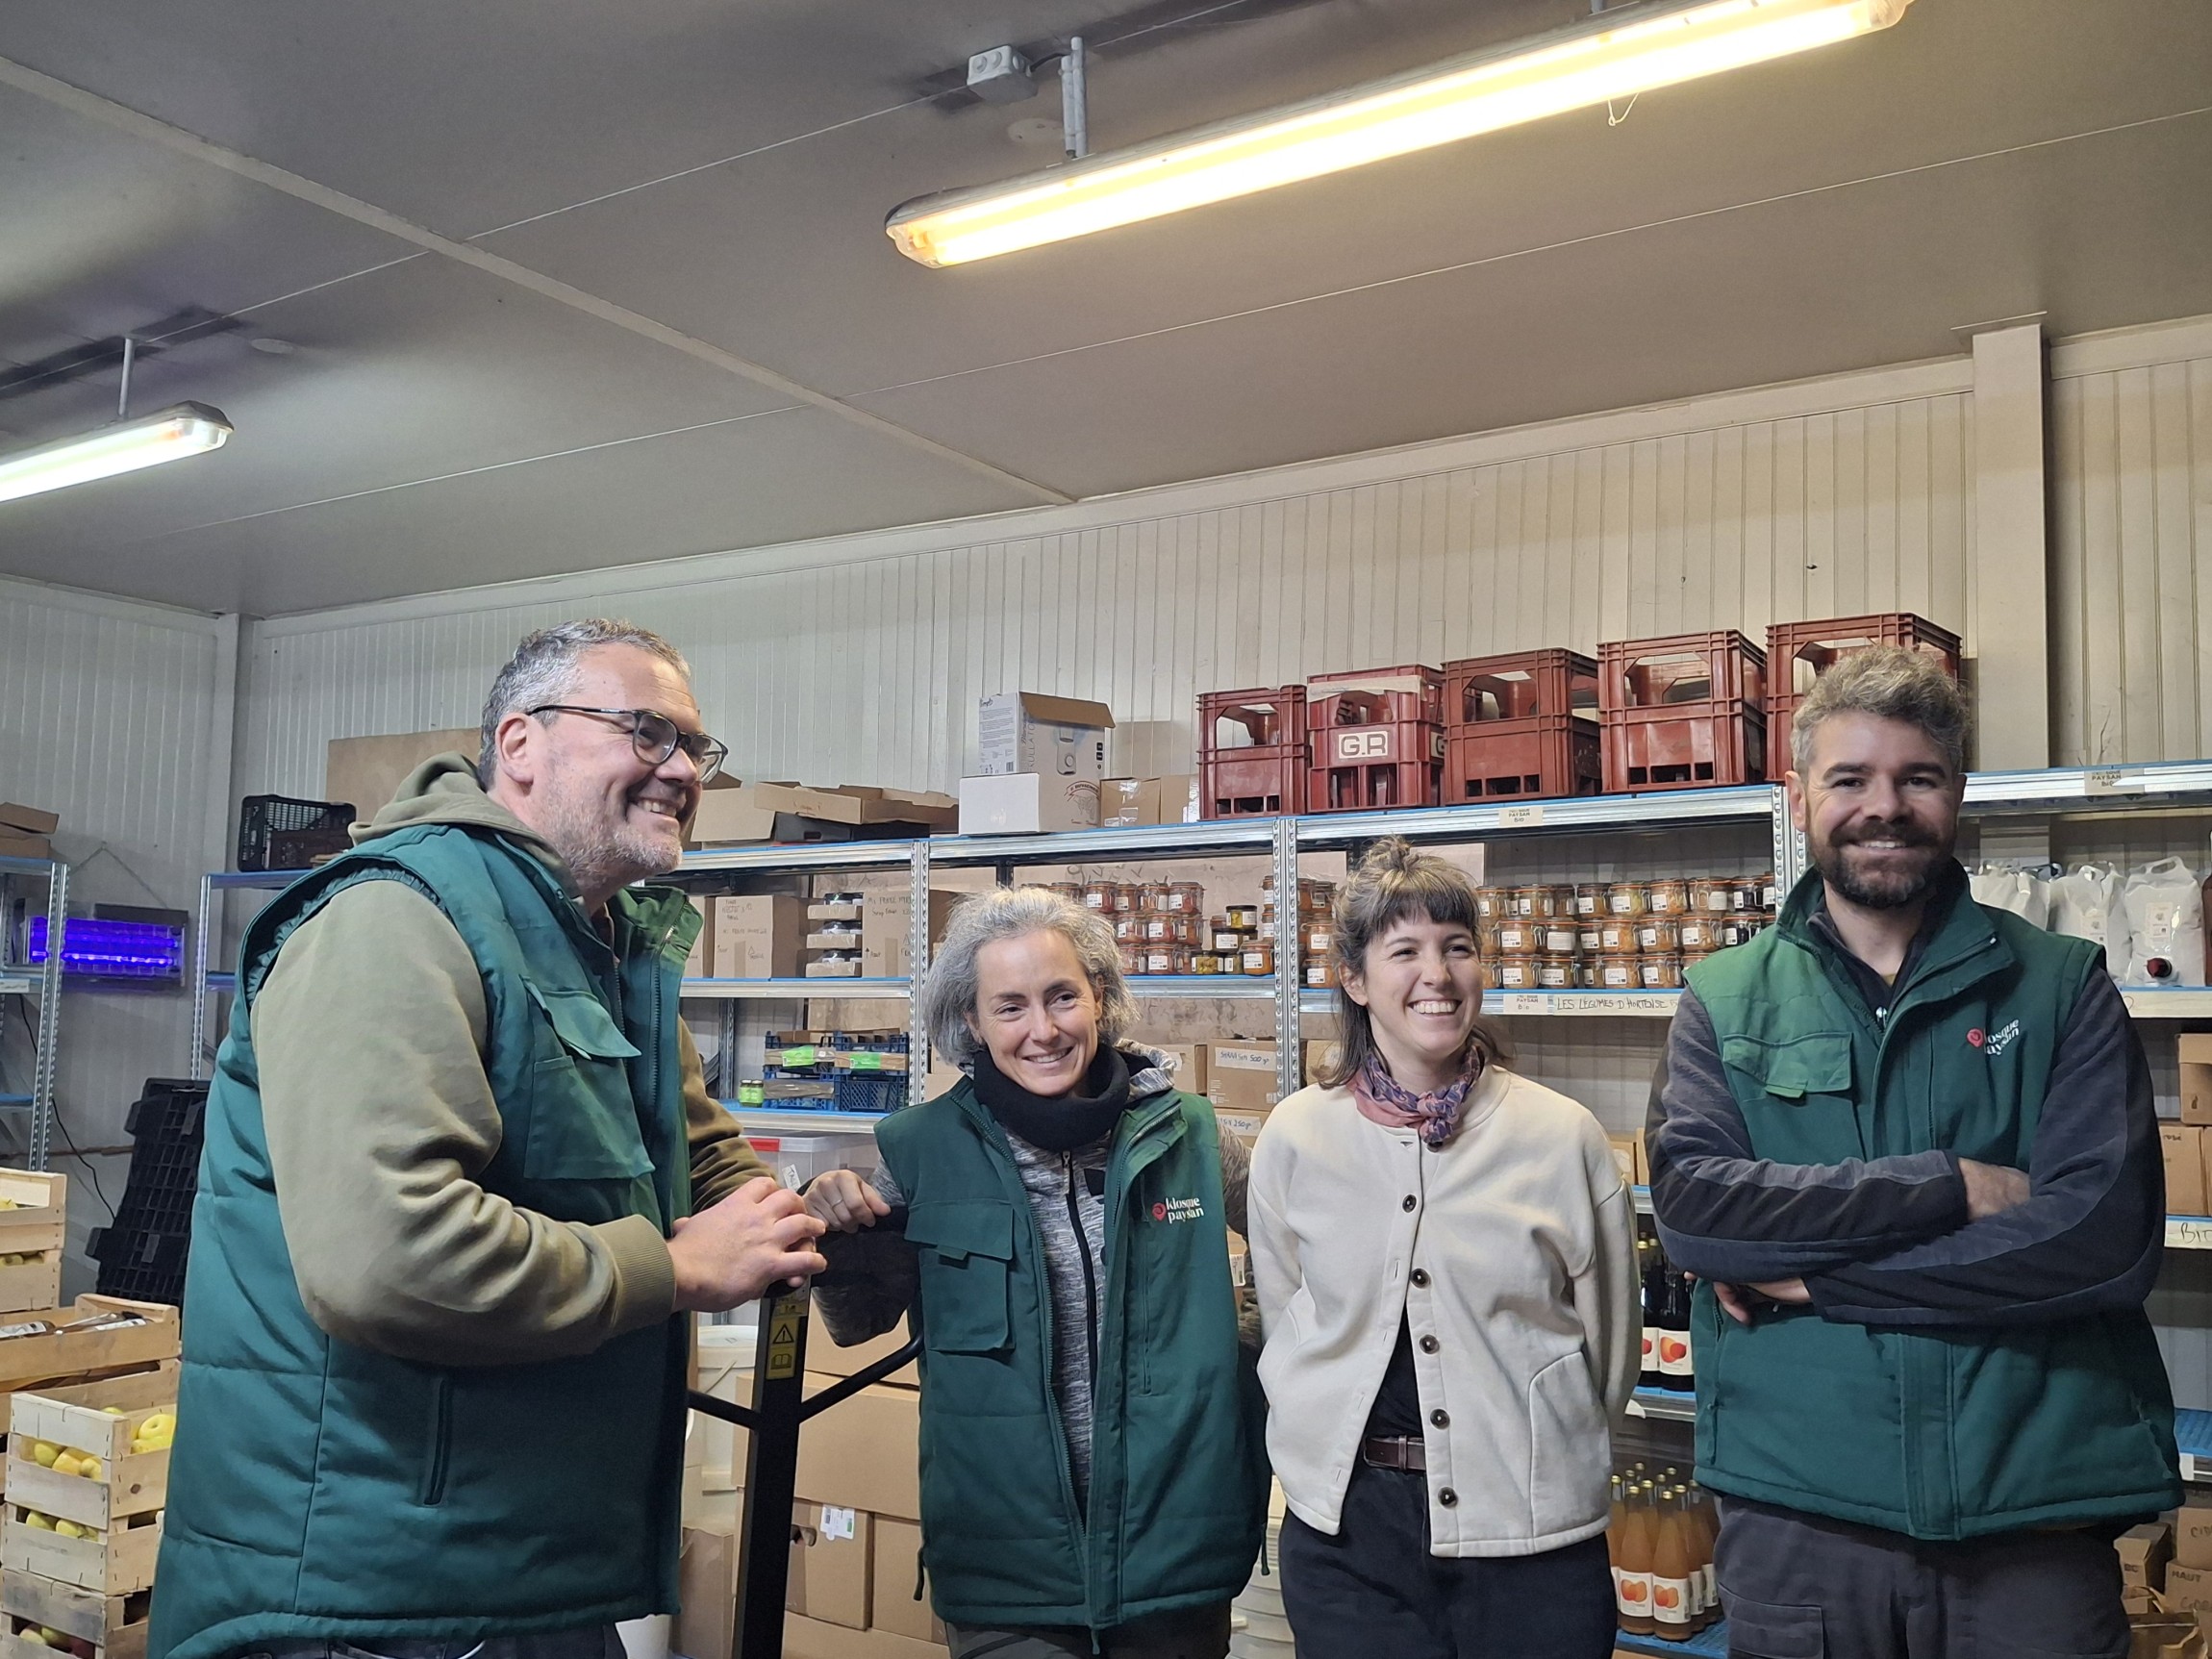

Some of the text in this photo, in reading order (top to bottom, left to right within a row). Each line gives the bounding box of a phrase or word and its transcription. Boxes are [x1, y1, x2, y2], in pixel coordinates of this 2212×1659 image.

[1341, 733, 1387, 757] G.R
[1557, 997, 1575, 1011] LES
[1985, 1028, 2019, 1056] aysan
[1168, 1208, 1205, 1224] paysan
